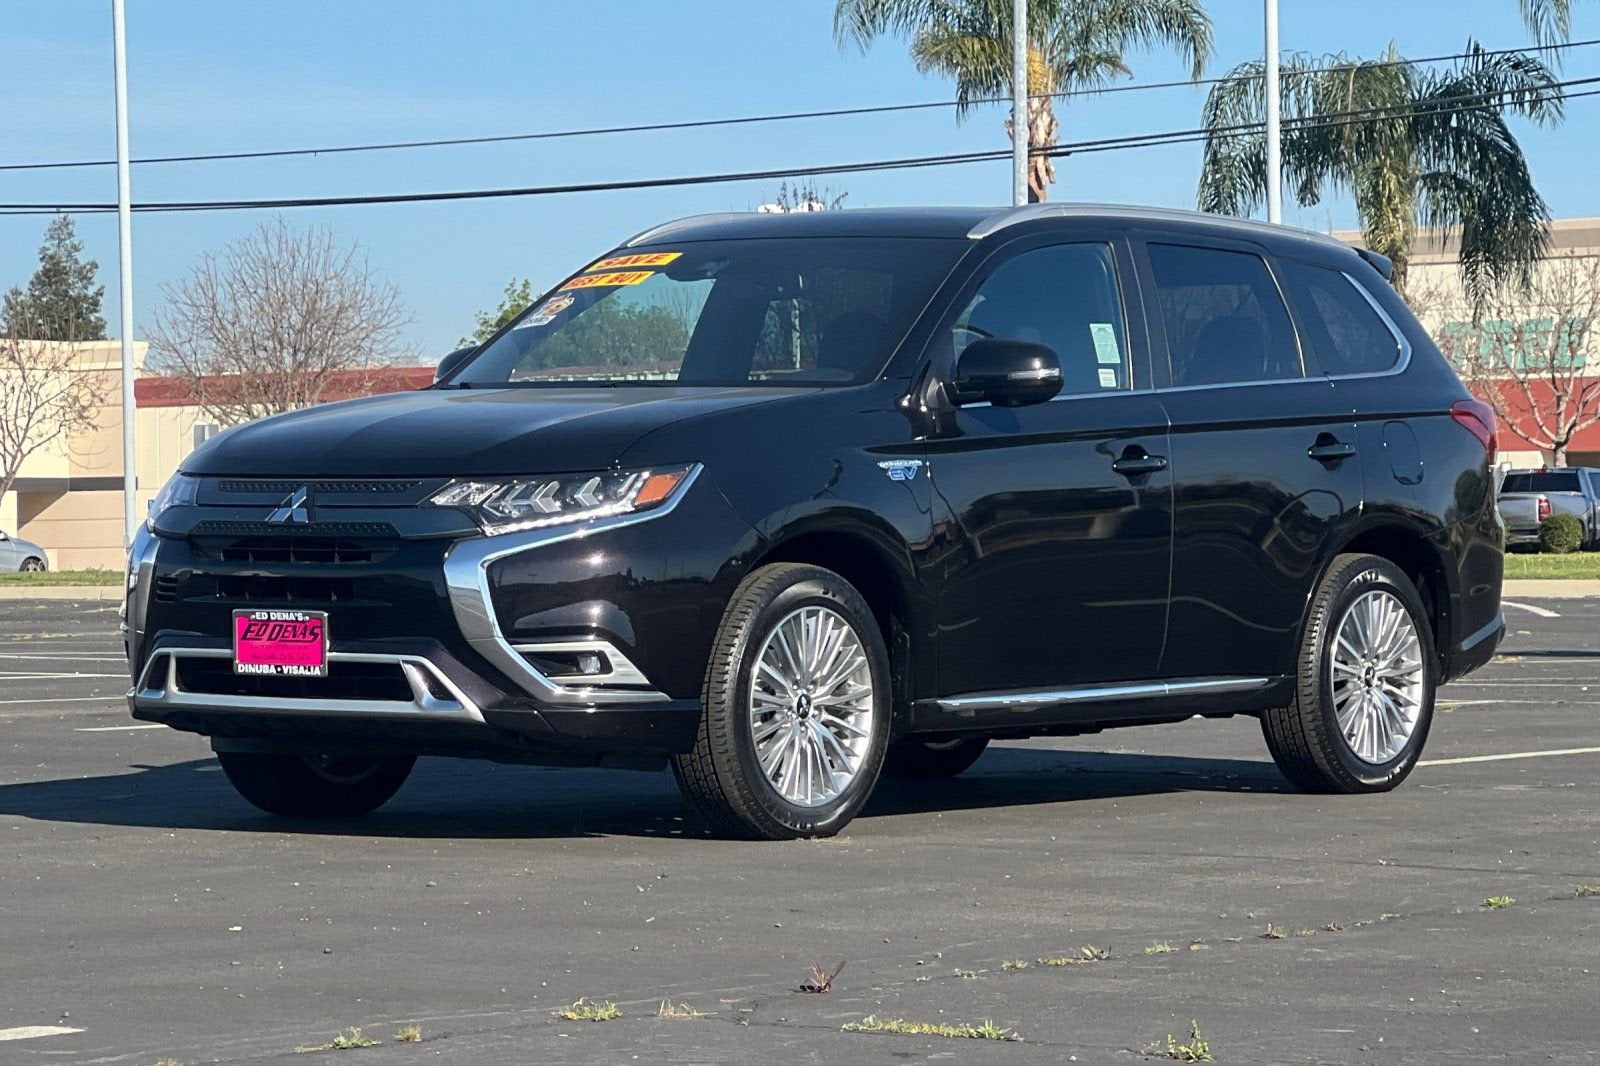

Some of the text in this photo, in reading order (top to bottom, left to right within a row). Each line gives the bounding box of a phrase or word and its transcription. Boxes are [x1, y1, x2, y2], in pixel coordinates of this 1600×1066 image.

[596, 253, 670, 269] SAVE
[606, 273, 650, 284] BUY
[888, 466, 917, 481] EV
[255, 611, 304, 621] ED DENA'S
[241, 622, 268, 641] ED
[238, 664, 321, 675] DINUBA VISALIA
